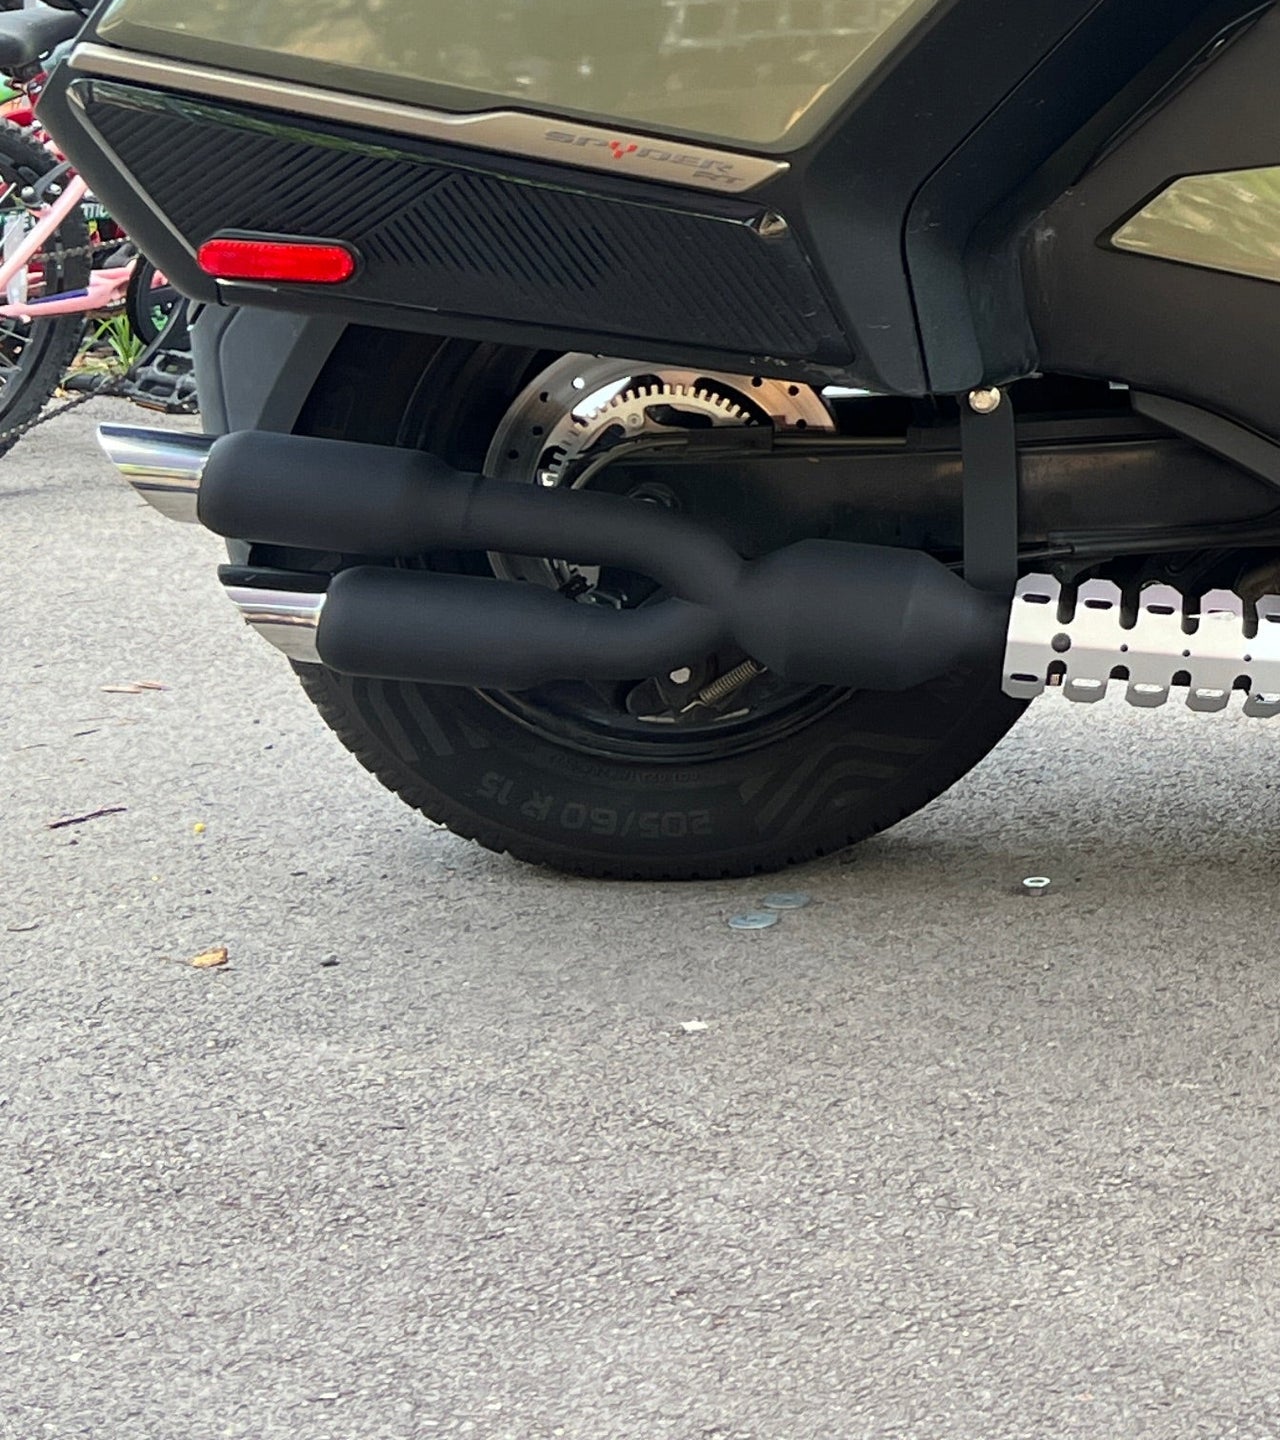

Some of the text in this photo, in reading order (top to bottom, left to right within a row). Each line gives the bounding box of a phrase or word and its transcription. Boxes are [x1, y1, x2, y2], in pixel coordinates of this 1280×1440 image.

[544, 131, 734, 172] SPYDER
[692, 170, 744, 184] RT
[476, 770, 514, 805] 15
[521, 790, 552, 821] R
[559, 802, 712, 839] 205/60
